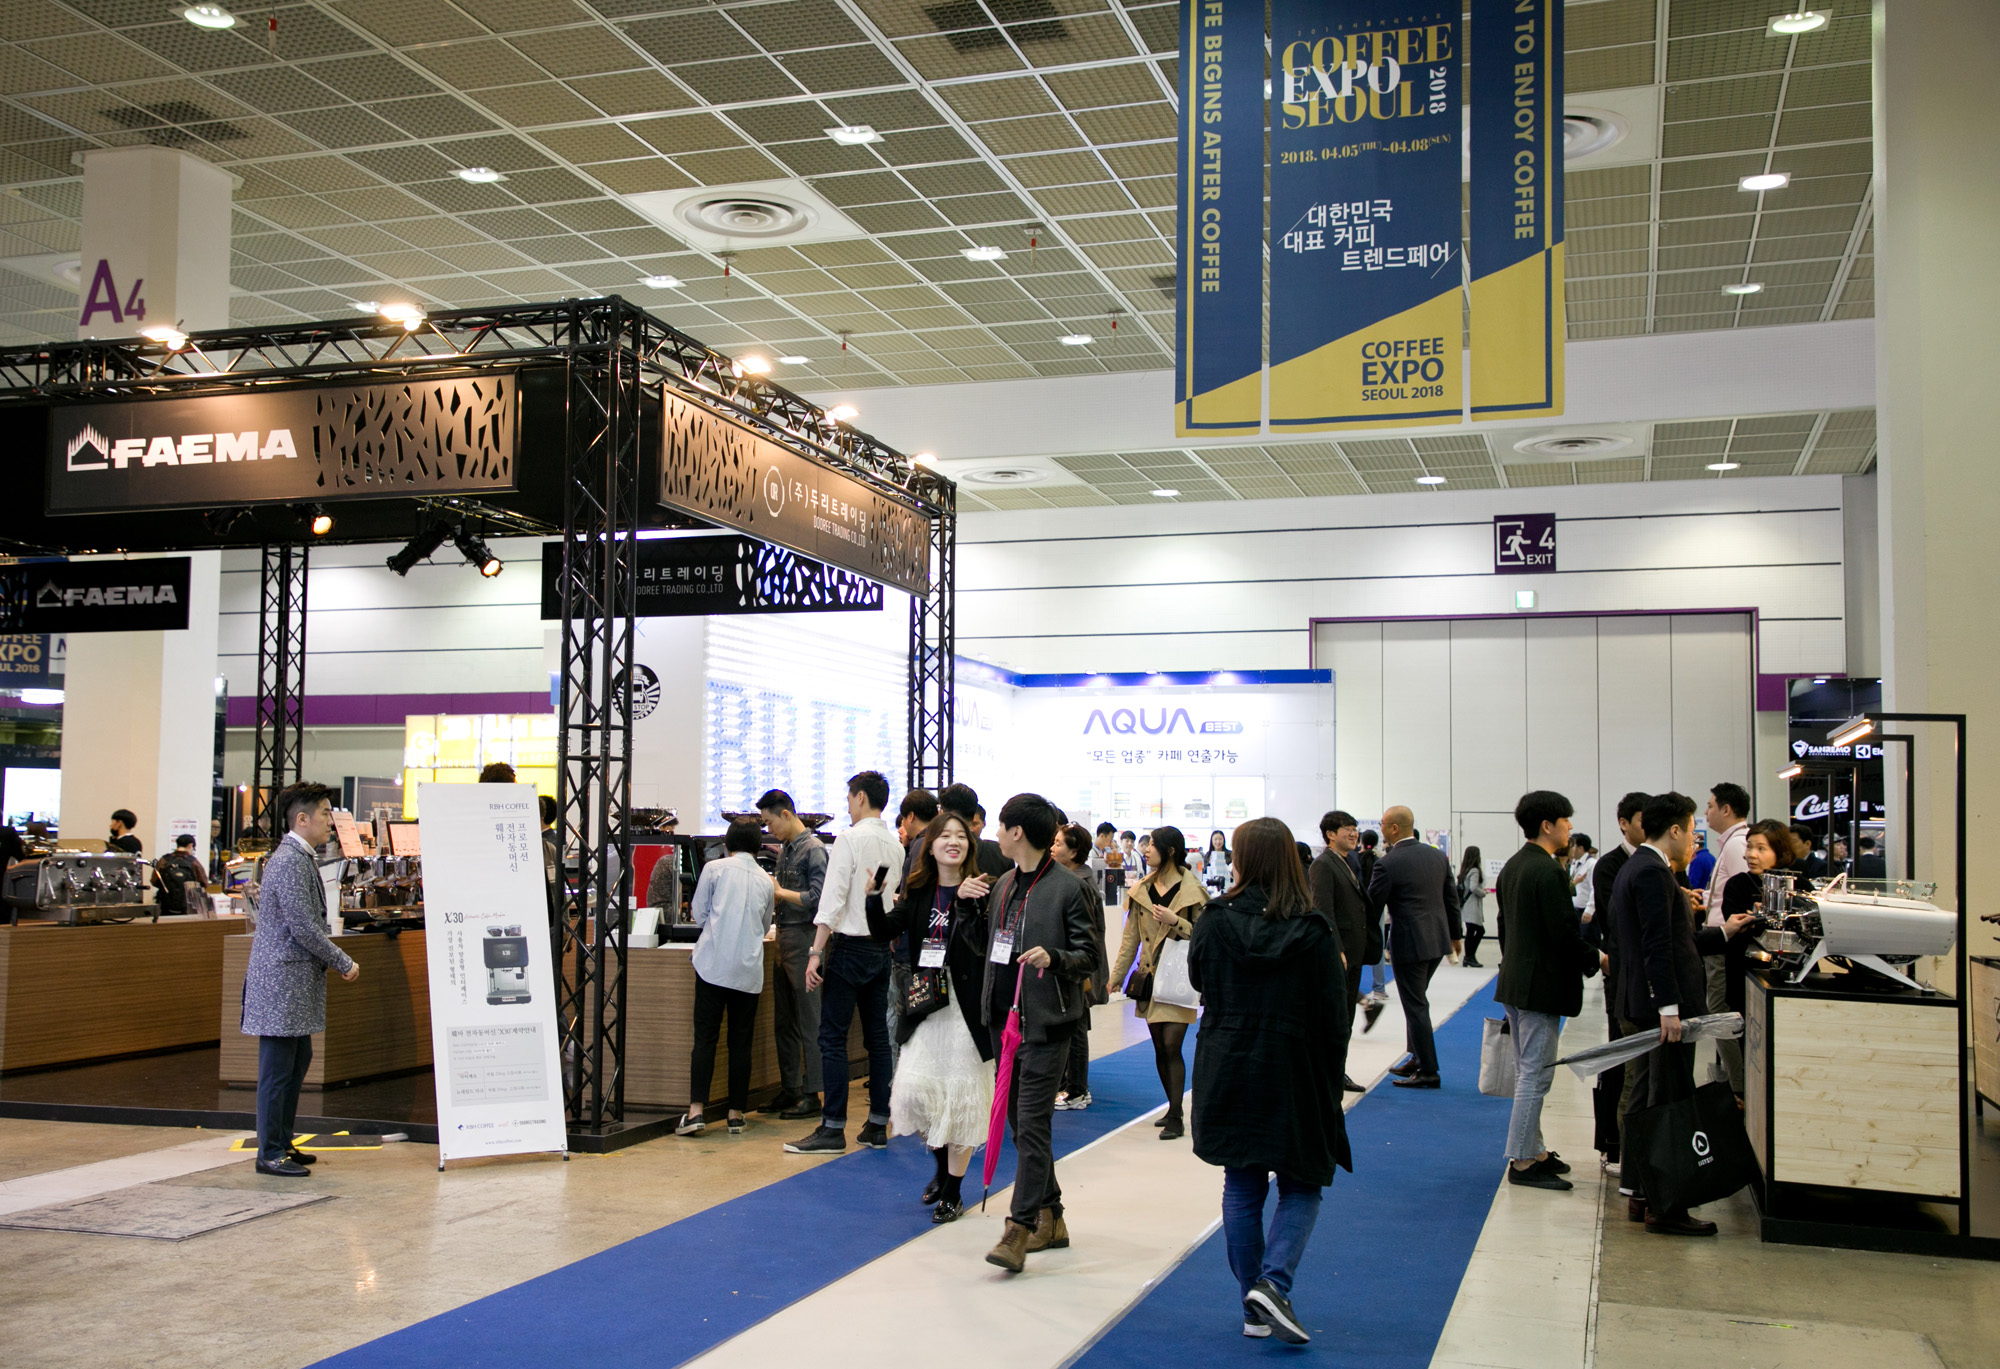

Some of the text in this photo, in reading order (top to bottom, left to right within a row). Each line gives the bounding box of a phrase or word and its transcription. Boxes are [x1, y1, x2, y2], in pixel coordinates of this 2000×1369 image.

[1282, 23, 1452, 78] COFFEE
[1514, 19, 1535, 54] TO
[1281, 56, 1401, 104] EXPO
[1429, 66, 1447, 115] 2018
[1282, 80, 1425, 130] SEOUL
[1514, 62, 1535, 142] ENJOY
[1201, 0, 1222, 293] FE BEGINS AFTER COFFEE
[1280, 149, 1318, 164] 2018.
[1514, 150, 1535, 240] COFFEE
[1307, 199, 1394, 227] 대한민국
[1284, 223, 1375, 253] 대표 커피
[1341, 241, 1449, 272] 트렌드페어
[79, 259, 147, 326] A4
[1361, 337, 1444, 360] COFFEE
[1362, 357, 1444, 386] EXPO
[1361, 385, 1444, 401] SEOUL 2018
[111, 429, 298, 469] FAEMA
[832, 522, 850, 541] TRADING
[1538, 527, 1555, 550] 4
[1526, 553, 1553, 565] EXIT
[64, 585, 178, 607] FAEMA
[636, 585, 660, 595] OOREE
[662, 584, 694, 595] TRADING
[15, 663, 40, 673] 2018
[1083, 708, 1240, 735] AQUA BEST
[1157, 749, 1182, 761] 카페
[1187, 749, 1239, 764] 연출가능
[518, 823, 529, 862] 프로모션
[445, 912, 464, 924] X30
